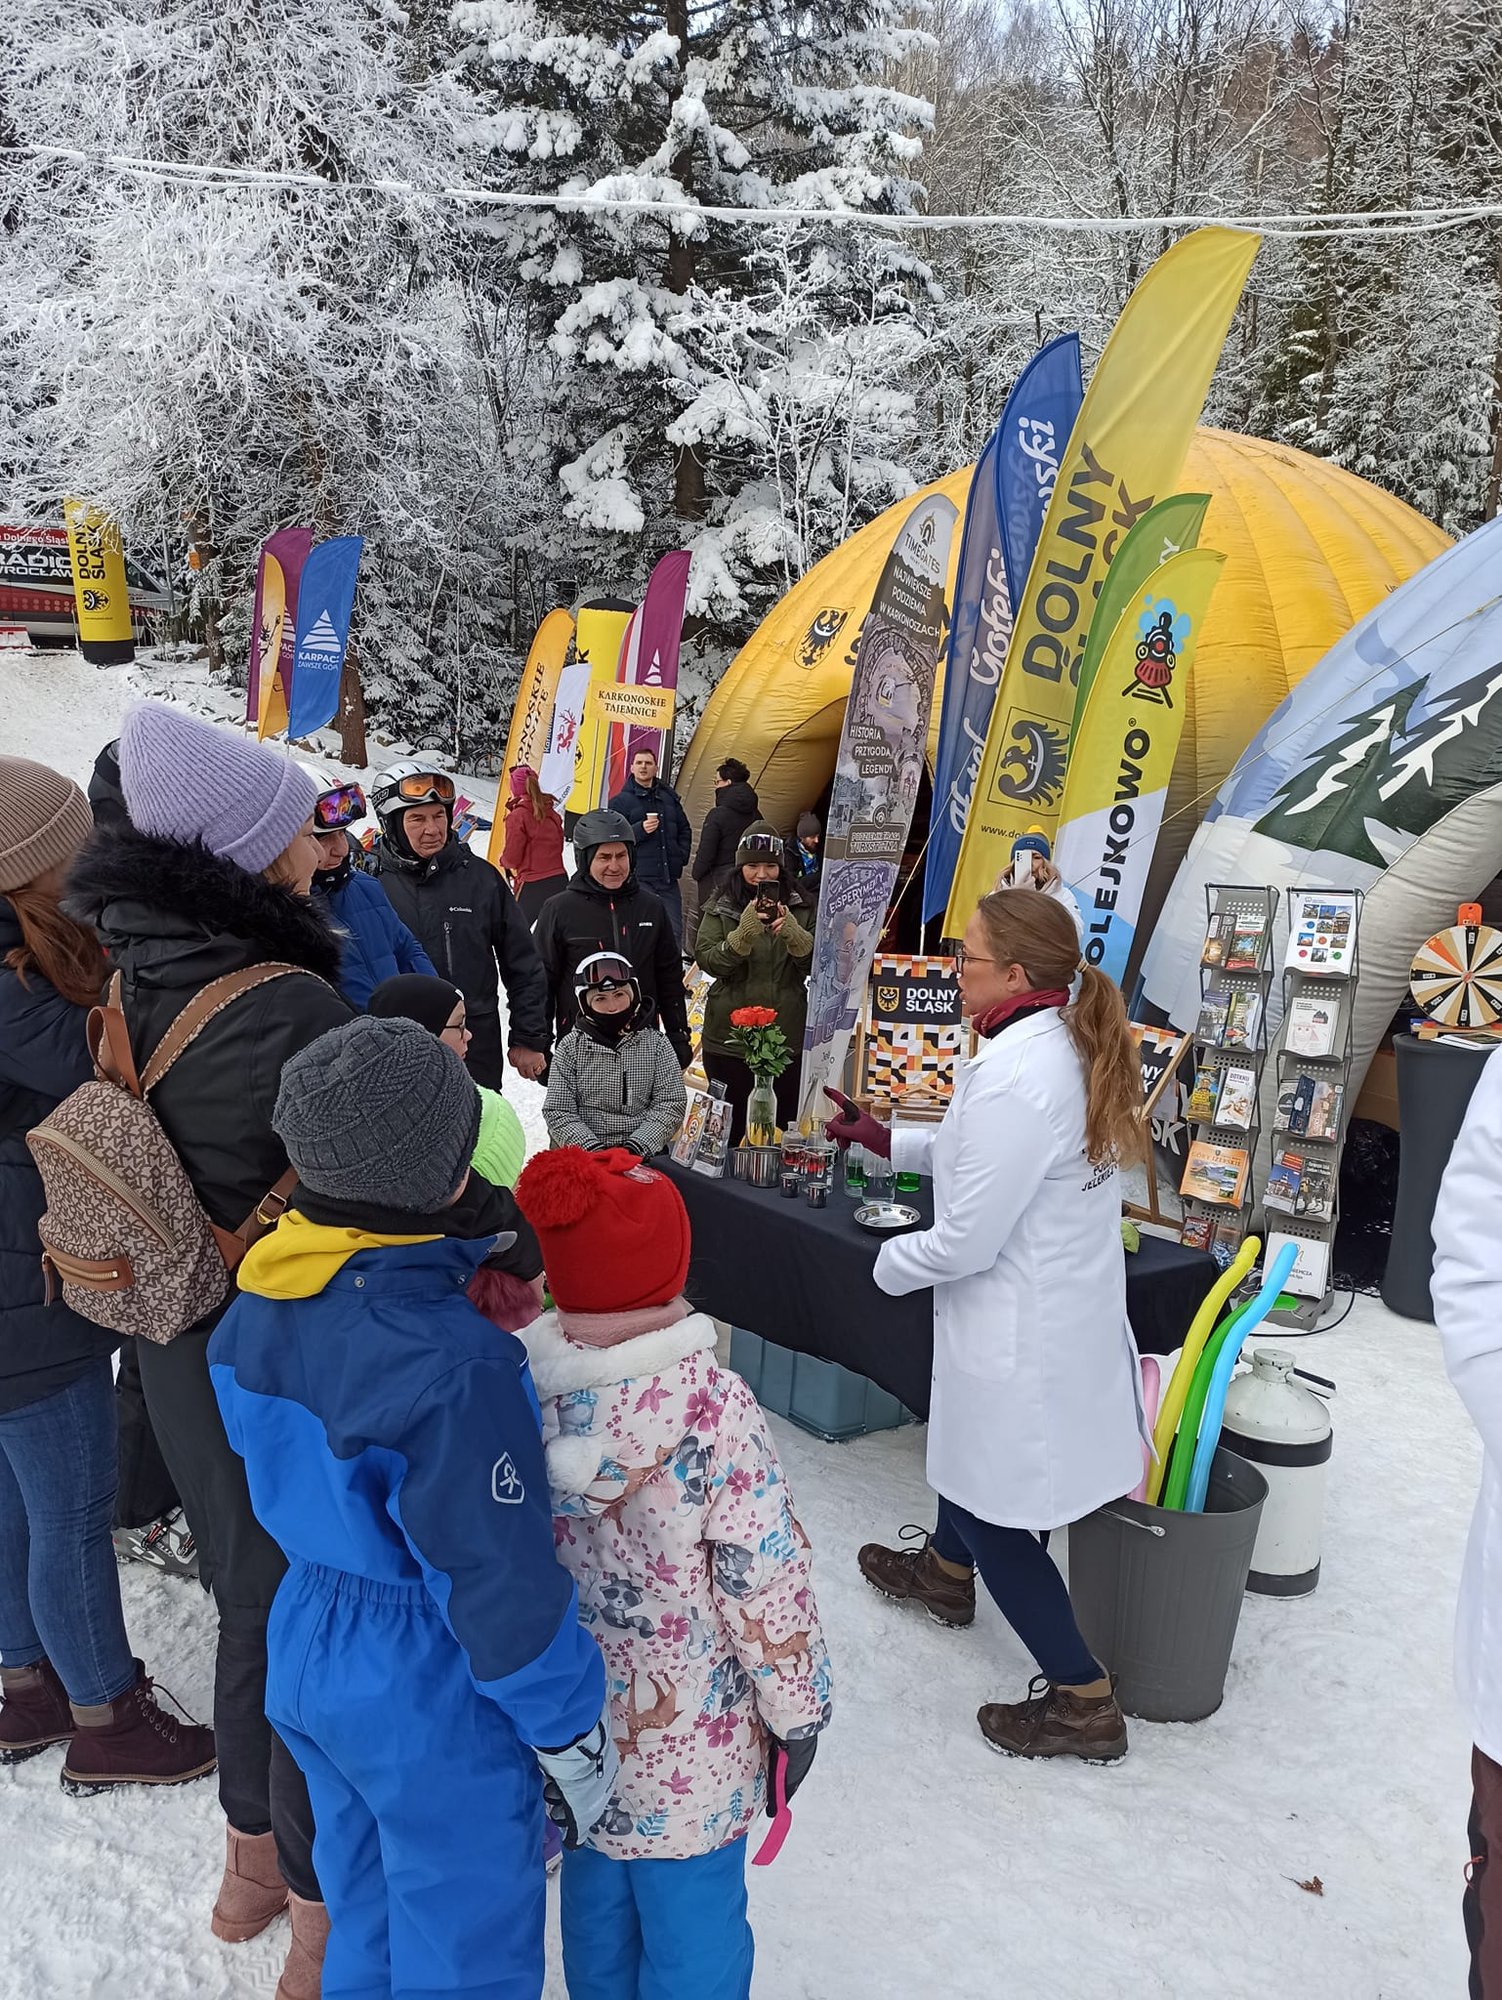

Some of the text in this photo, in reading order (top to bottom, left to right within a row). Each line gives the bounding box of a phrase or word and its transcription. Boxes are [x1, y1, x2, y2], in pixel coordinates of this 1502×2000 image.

[0, 553, 72, 568] ADIO
[905, 533, 940, 573] TIMEGATES
[1022, 441, 1115, 683] DOLNY
[893, 565, 931, 600] NAJWIĘKSZE
[892, 586, 927, 616] PODZIEMIA
[880, 601, 940, 637] W KARKONOSZACH
[598, 690, 667, 707] KARKONOSKIE
[604, 702, 657, 718] TAJEMNICE
[850, 726, 881, 740] HISTORIA
[855, 746, 891, 757] PRZYGODA
[861, 764, 893, 774] LEGENDY
[1086, 728, 1151, 966] OLEJKOWO
[906, 987, 958, 1001] DOLNY
[905, 1000, 954, 1014] ŚLĄSK
